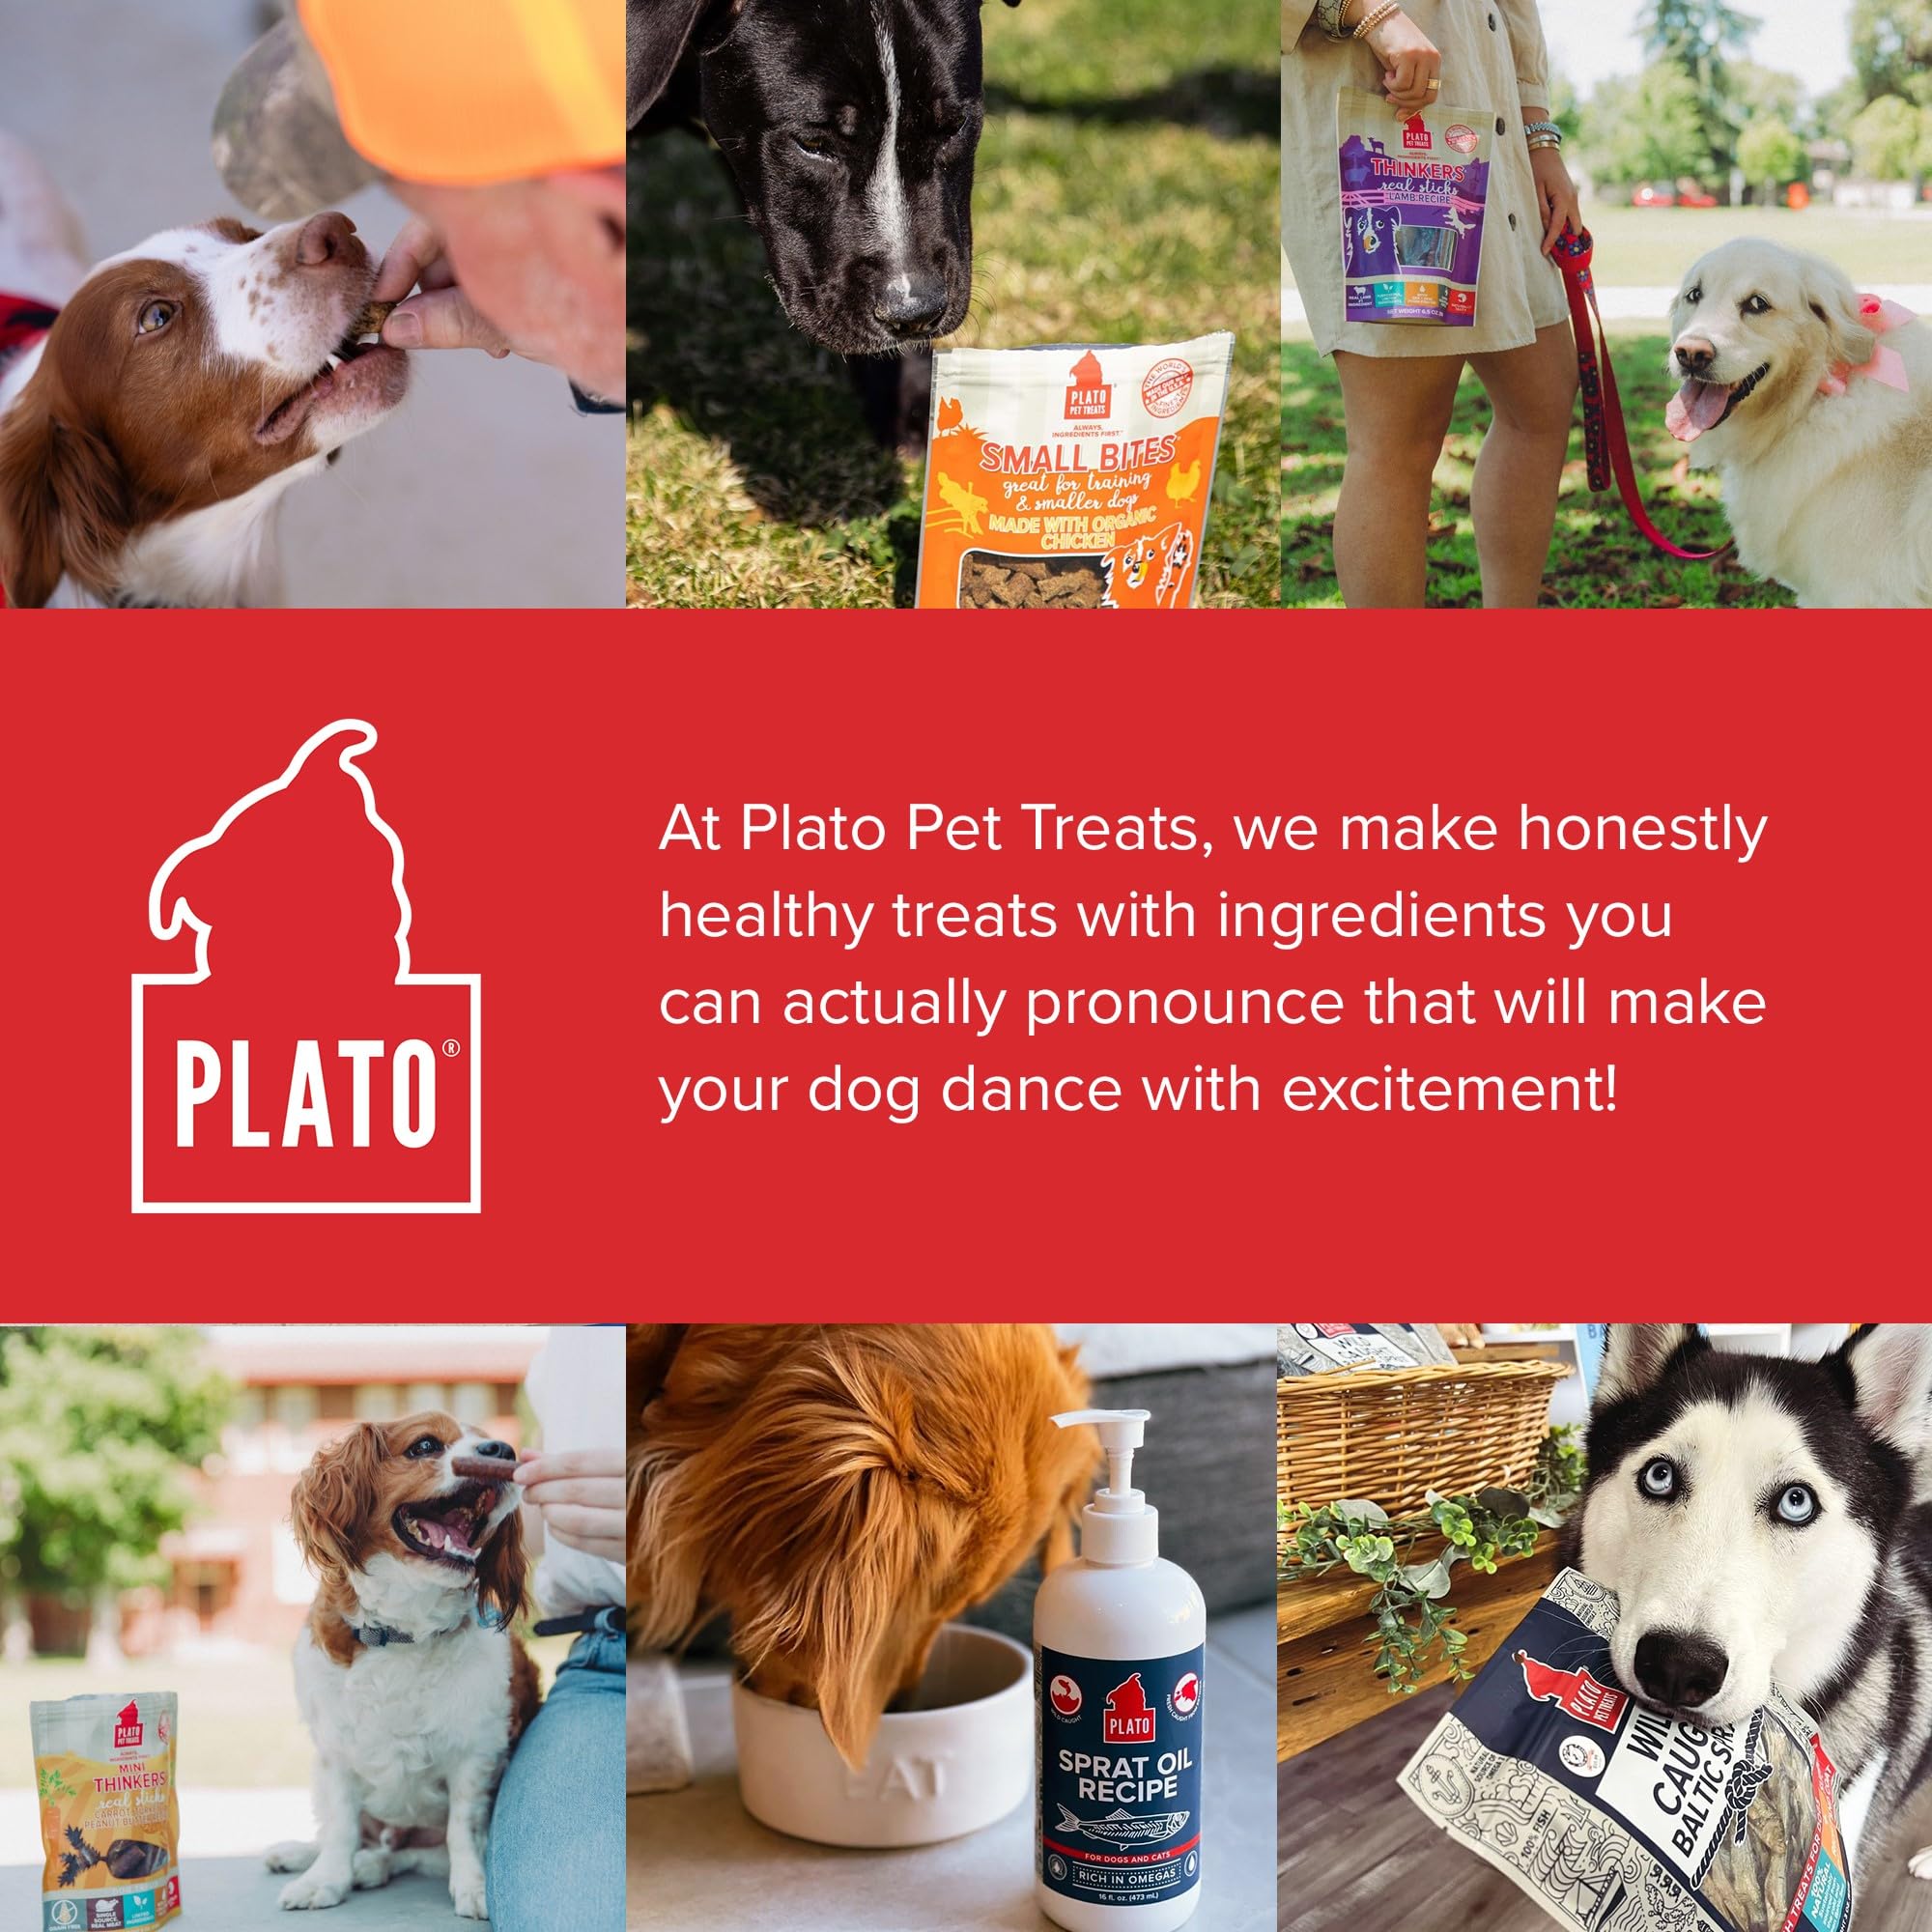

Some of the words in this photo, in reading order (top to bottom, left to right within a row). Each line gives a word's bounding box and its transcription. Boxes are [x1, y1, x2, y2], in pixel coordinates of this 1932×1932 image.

[1406, 132, 1429, 141] PLATO
[1371, 157, 1464, 183] THINKERS
[1378, 178, 1415, 192] real
[1419, 179, 1460, 196] sticks
[1389, 192, 1415, 202] LAMB
[1419, 194, 1450, 204] RECIPE
[1071, 389, 1106, 405] PLATO
[1069, 406, 1081, 414] PET
[1083, 405, 1105, 414] TREATS
[980, 440, 1090, 474] SMALL
[1097, 434, 1177, 473] BITES
[1003, 472, 1049, 498] great
[1055, 473, 1081, 495] for
[1088, 470, 1152, 490] training
[1016, 496, 1031, 511] &
[1035, 492, 1103, 511] smaller
[1107, 489, 1139, 512] dogs
[988, 514, 1041, 534] MADE
[1043, 515, 1090, 533] WITH
[1092, 505, 1157, 532] ORGANIC
[1040, 531, 1116, 550] CHICKEN
[1570, 1679, 1603, 1717] PLATO
[1599, 1691, 1618, 1712] TREATS
[1061, 1715, 1082, 1724] CAUGHT
[1110, 1718, 1151, 1735] PLATO
[1594, 1707, 1610, 1722] PET
[118, 1725, 140, 1738] PLATO
[1627, 1714, 1674, 1762] WIL
[119, 1762, 145, 1774] MINI
[1059, 1748, 1150, 1778] SPRAT
[1156, 1747, 1193, 1776] OIL
[1470, 1750, 1492, 1775] NATURAL
[1474, 1762, 1492, 1783] SOURCE
[1488, 1753, 1497, 1764] OF
[1487, 1761, 1502, 1780] OMEGA
[1653, 1720, 1709, 1816] CAUG
[94, 1771, 167, 1793] THINKERS
[1079, 1775, 1178, 1804] RECIPE
[1823, 1764, 1832, 1795] COAT
[1671, 1760, 1724, 1859] BALTIC
[85, 1818, 120, 1830] PEANUT
[1520, 1833, 1541, 1861] 100%
[1532, 1808, 1551, 1833] FISH
[1085, 1853, 1102, 1861] FOR
[1131, 1855, 1150, 1863] AND
[1151, 1851, 1171, 1861] CATS
[1079, 1870, 1107, 1884] RICH
[1112, 1875, 1123, 1885] IN
[1128, 1868, 1176, 1885] OMEGAS
[1790, 1863, 1814, 1916] TREATS
[1808, 1833, 1821, 1861] FOR
[1810, 1865, 1824, 1897] 100%
[1811, 1861, 1831, 1919] NATURAL
[1818, 1872, 1833, 1918] Sustainably
